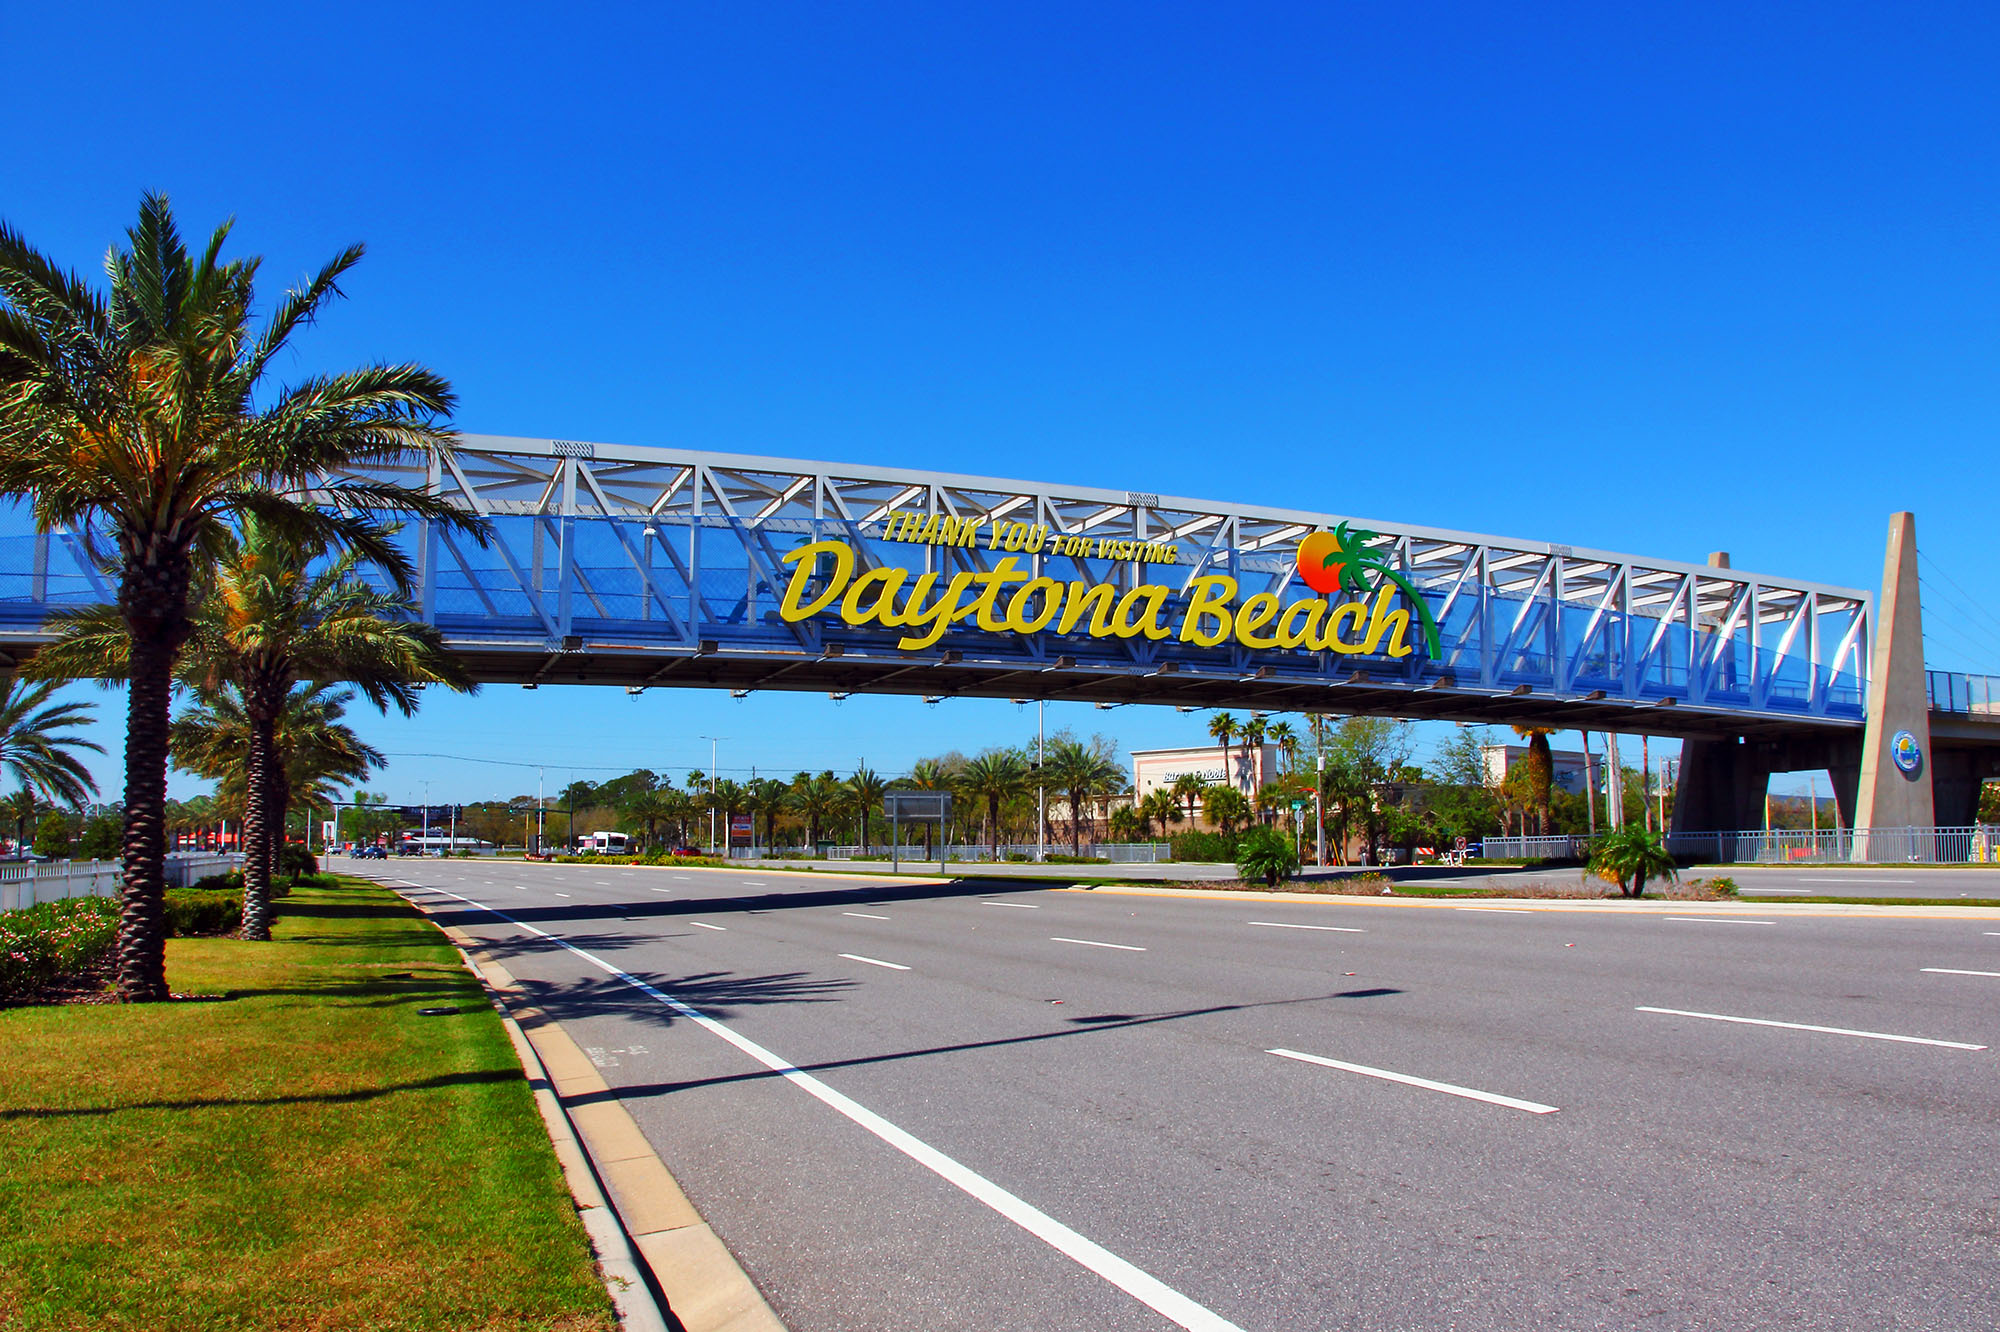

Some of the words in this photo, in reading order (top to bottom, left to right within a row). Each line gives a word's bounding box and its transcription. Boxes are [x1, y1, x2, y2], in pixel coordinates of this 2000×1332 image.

[882, 510, 984, 549] THANK
[988, 519, 1049, 555] YOU
[1051, 534, 1094, 559] FOR
[1097, 537, 1179, 565] VISITING
[779, 540, 1172, 651] Daytona
[1179, 574, 1413, 658] Beach
